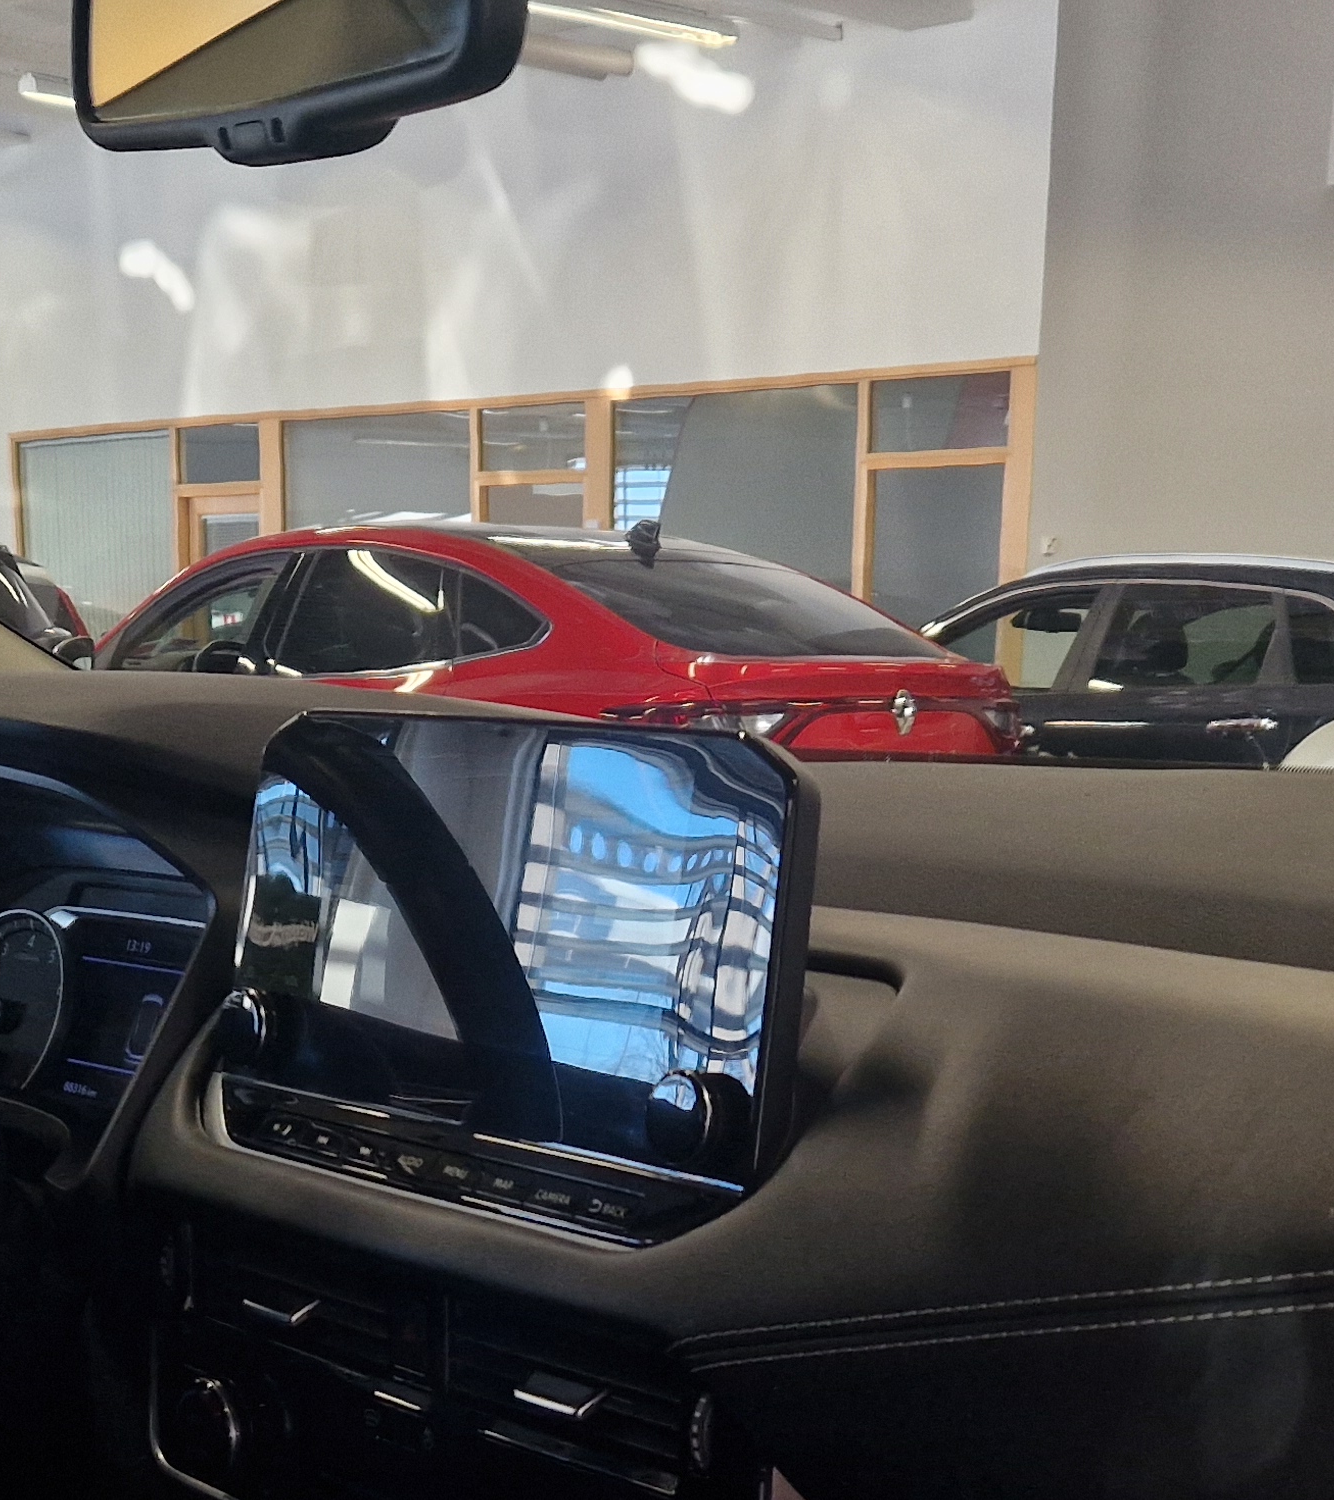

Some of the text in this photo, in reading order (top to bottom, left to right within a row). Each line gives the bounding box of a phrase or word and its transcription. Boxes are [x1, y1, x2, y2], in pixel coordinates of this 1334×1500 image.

[126, 938, 152, 954] 13:19
[492, 1177, 515, 1190] MAP
[534, 1188, 572, 1206] CAMERA
[602, 1202, 627, 1219] BACK
